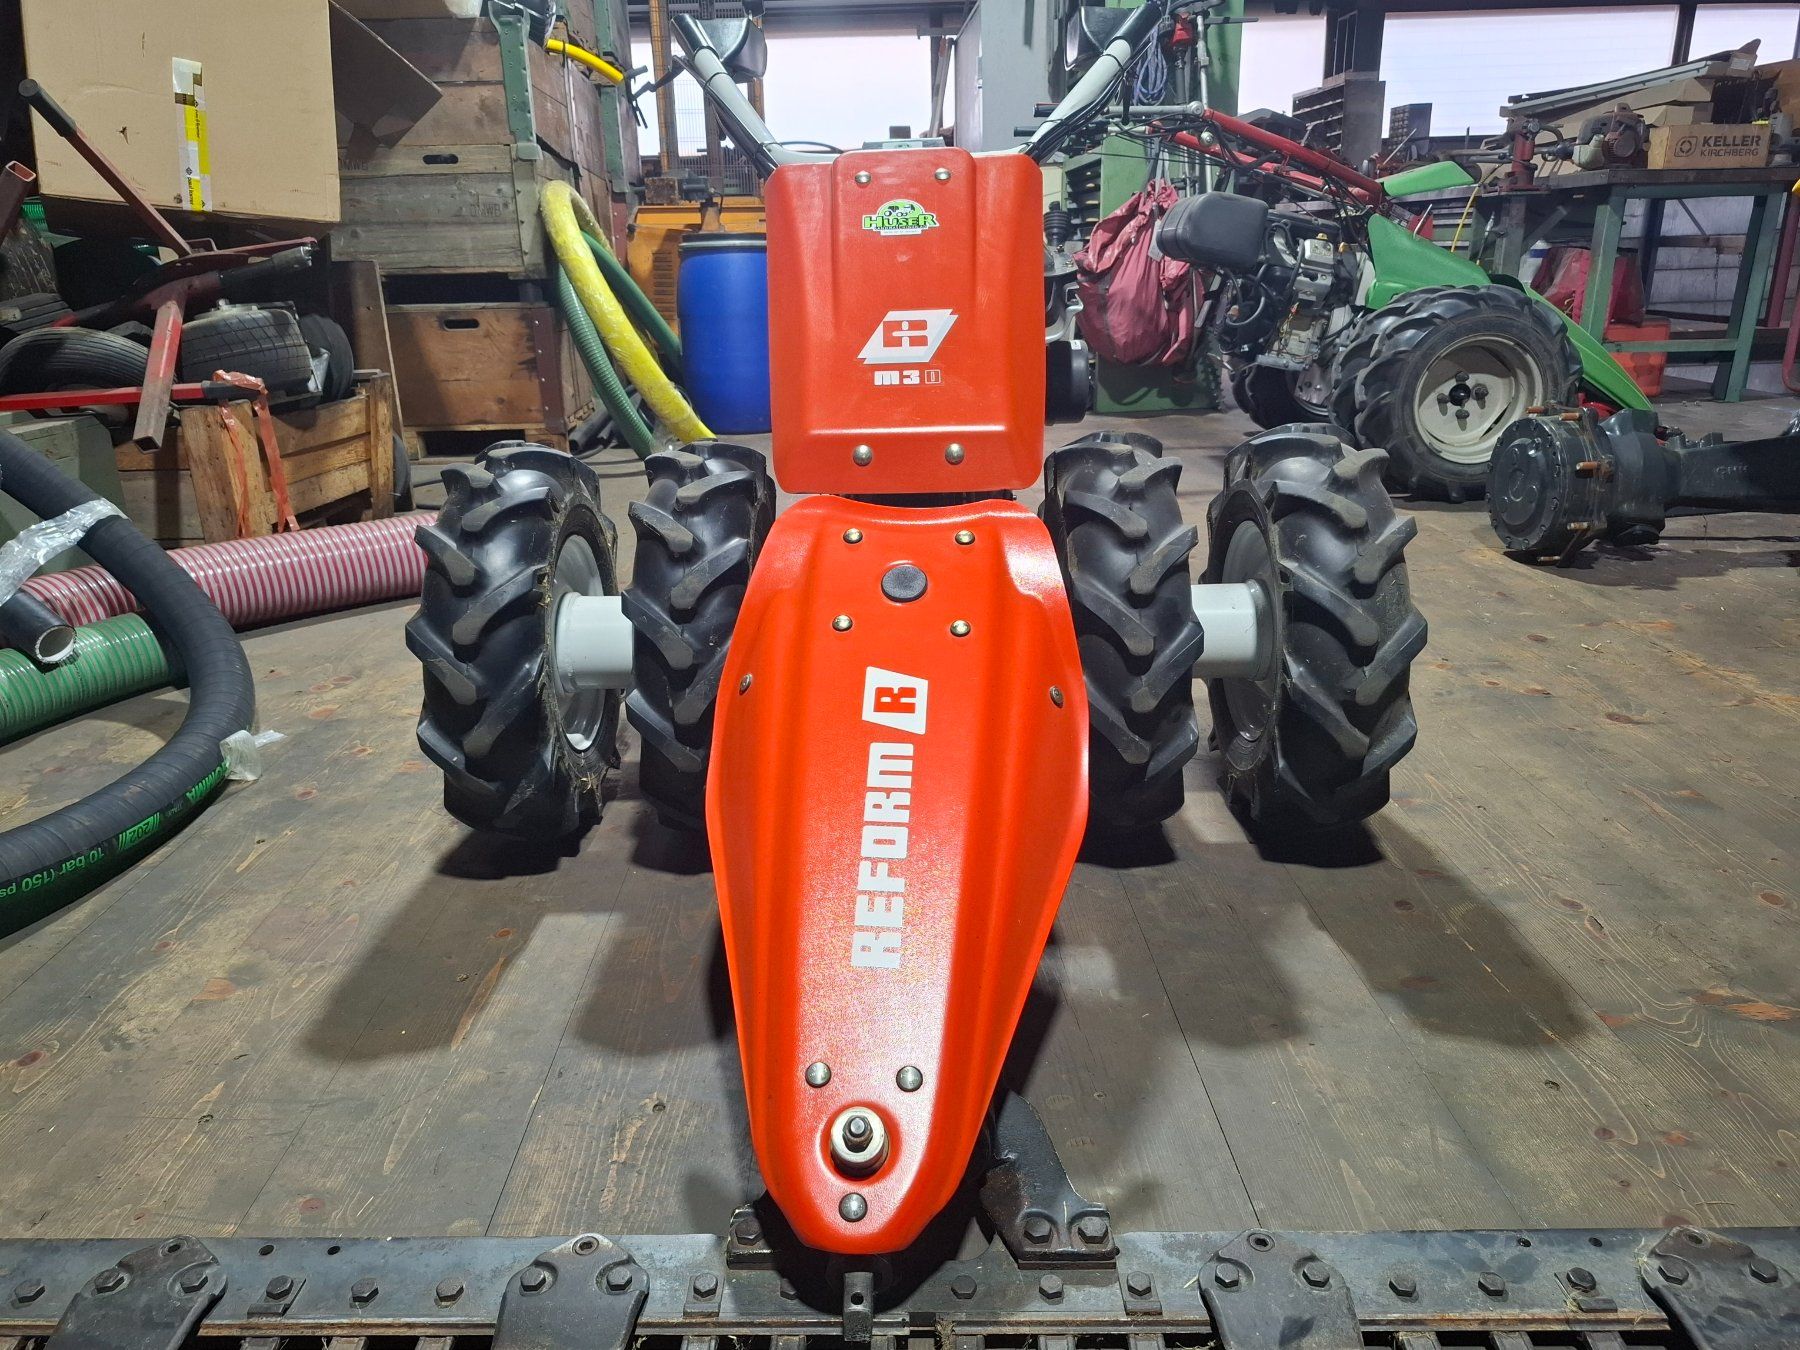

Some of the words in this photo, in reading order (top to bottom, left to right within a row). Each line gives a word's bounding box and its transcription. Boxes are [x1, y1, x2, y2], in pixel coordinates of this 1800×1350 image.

[1701, 135, 1761, 147] KELLER
[1700, 148, 1759, 157] KIRCHBERG
[863, 213, 937, 229] HUSER
[88, 847, 104, 863] 10
[851, 742, 914, 969] REFORM
[59, 855, 86, 875] bar
[22, 868, 55, 892] (150
